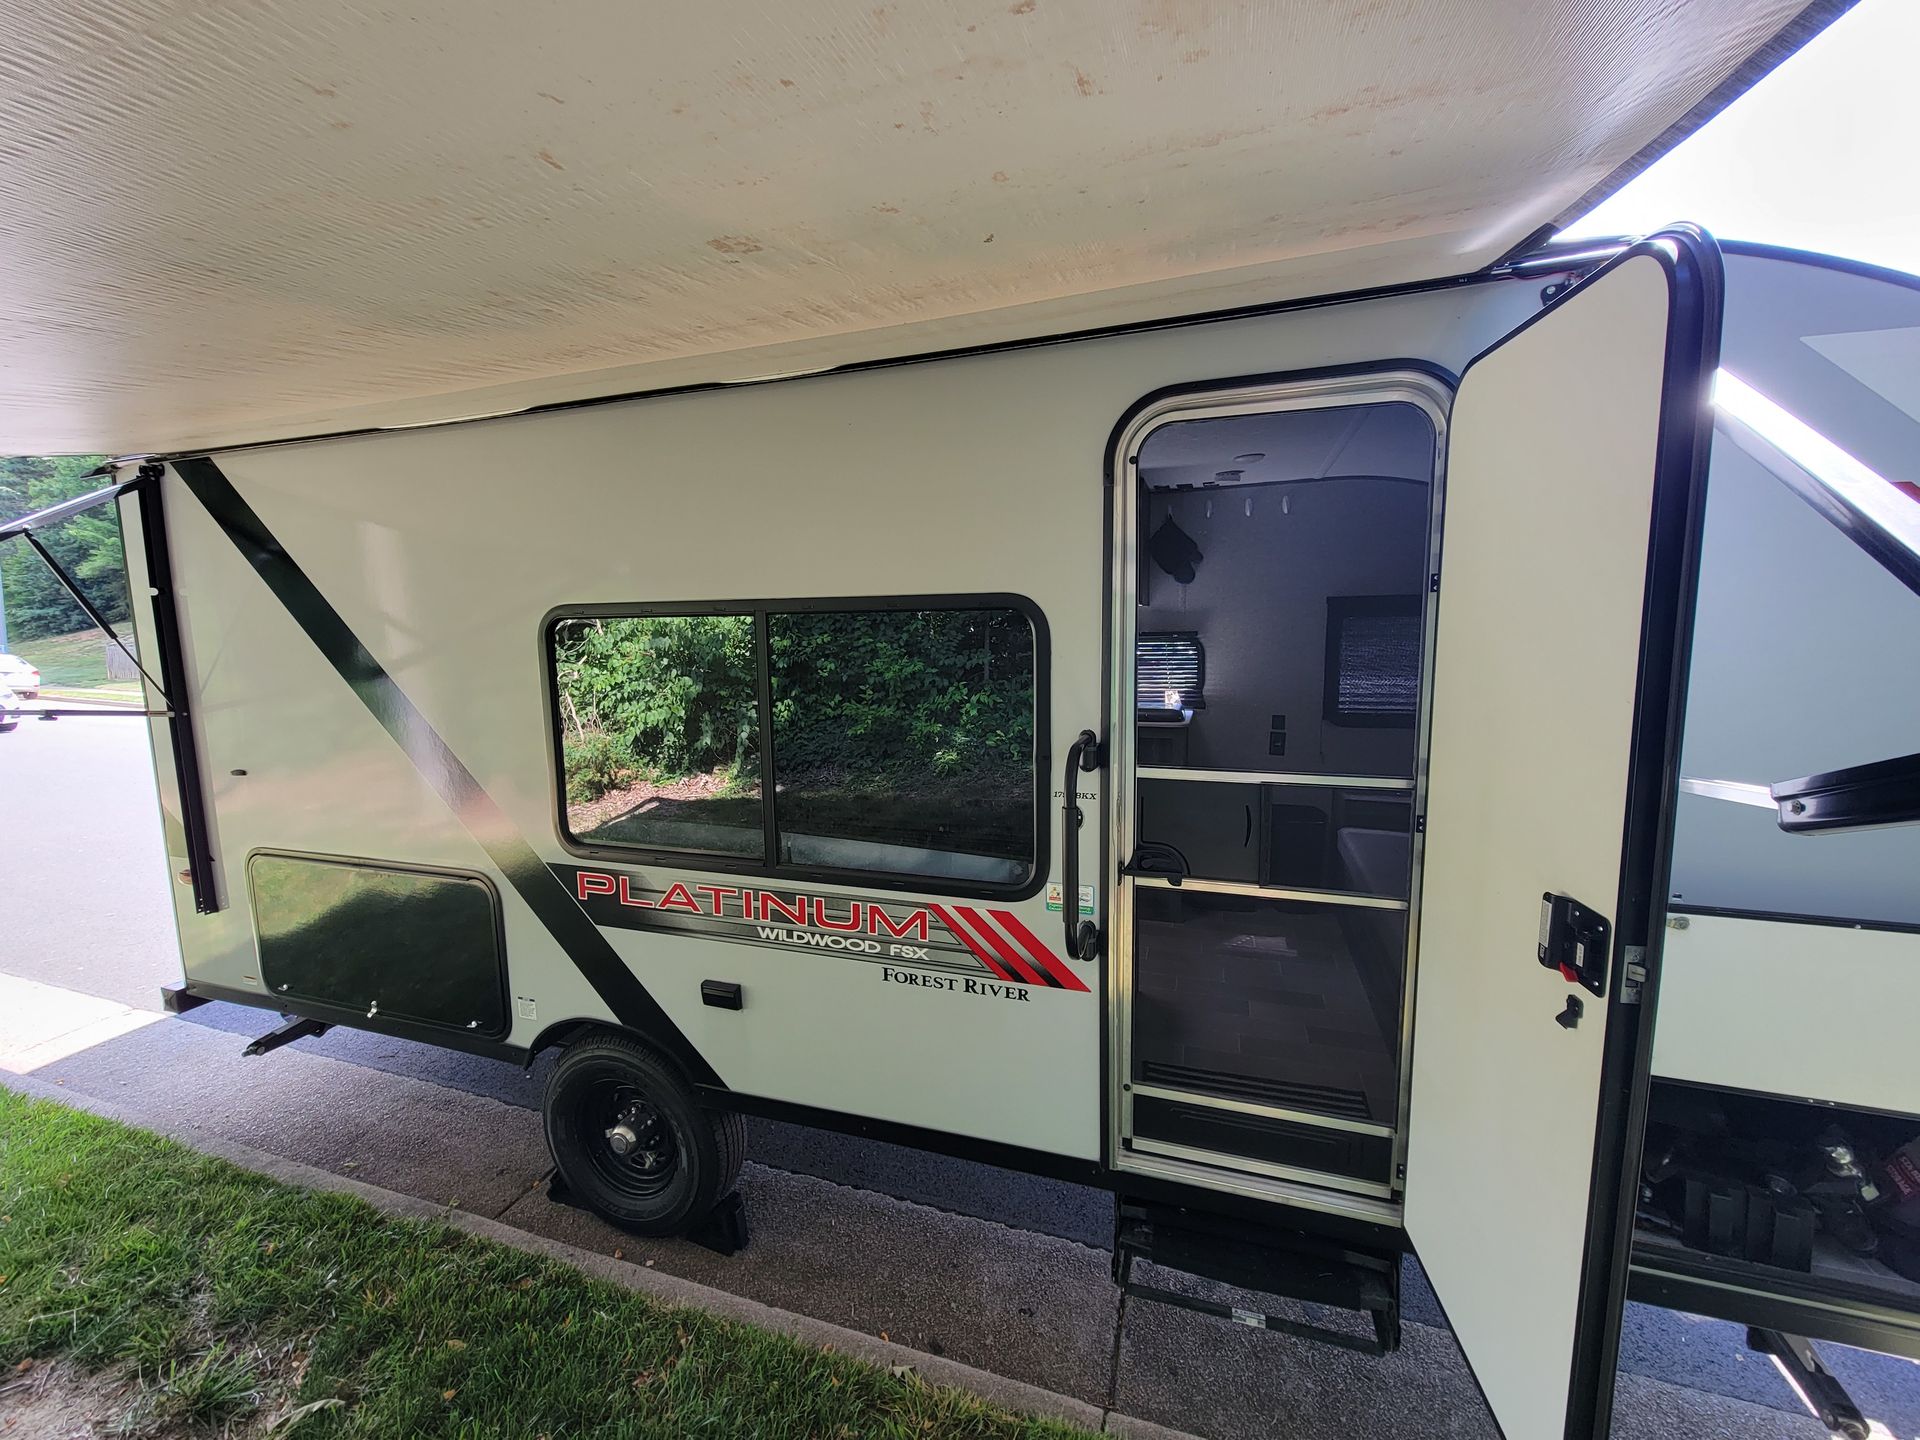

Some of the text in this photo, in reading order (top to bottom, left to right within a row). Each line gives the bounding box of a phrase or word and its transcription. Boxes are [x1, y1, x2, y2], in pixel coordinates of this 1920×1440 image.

[576, 871, 929, 942] PLATINUM
[756, 926, 931, 960] WILDWOOD FSX
[881, 967, 1031, 1002] FOREST RIVER
